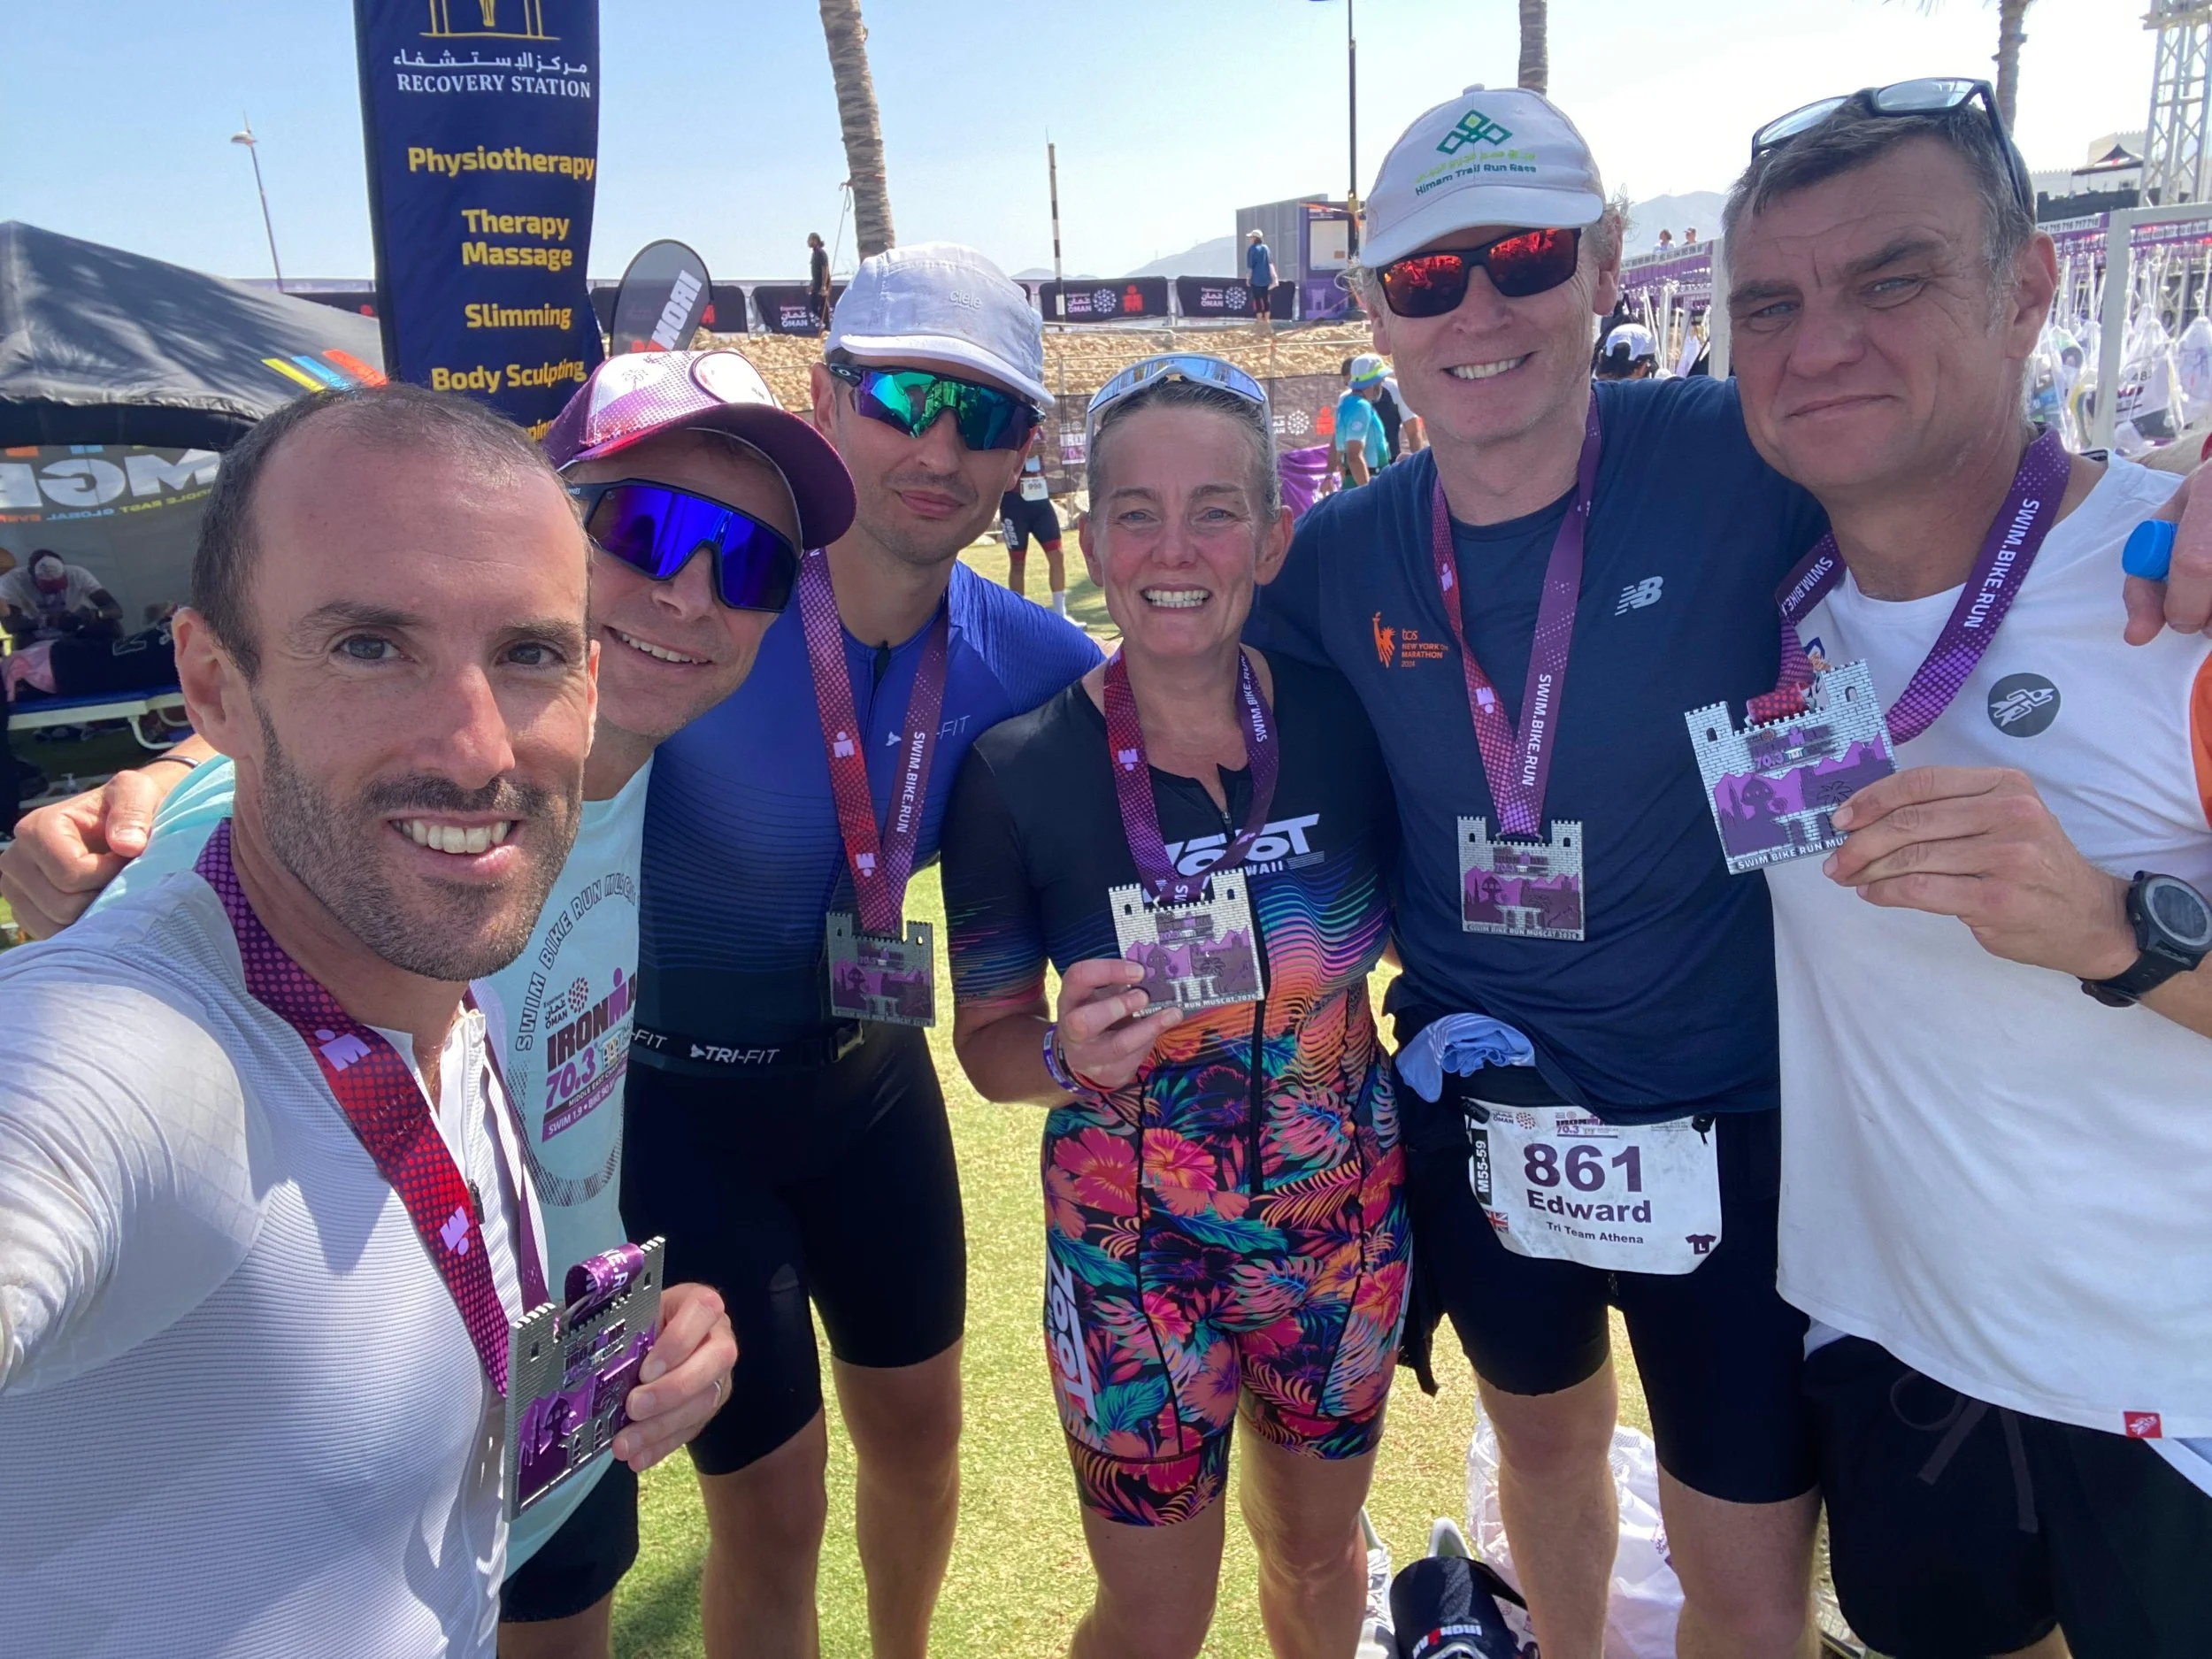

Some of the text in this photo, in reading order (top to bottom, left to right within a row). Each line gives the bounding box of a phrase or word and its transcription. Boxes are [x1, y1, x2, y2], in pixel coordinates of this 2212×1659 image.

[536, 56, 588, 73] مركز
[396, 73, 591, 98] RECOVERY STATION
[407, 145, 595, 181] Physiotherapy
[1416, 174, 1453, 196] Himam
[1455, 164, 1480, 177] Trail
[1509, 164, 1537, 173] Race
[461, 209, 571, 241] Therapy
[462, 241, 573, 272] Massage
[465, 303, 573, 331] Slimming
[781, 319, 809, 328] OMAN
[1068, 304, 1093, 313] OMAN
[431, 358, 588, 394] Body Sculpting
[1963, 498, 2040, 629] SWIM.BIKE.RUN
[1521, 674, 1552, 787] SWIM.BIKE.RUN
[896, 731, 926, 833] SWIM.BIKE.RUN
[1738, 855, 1769, 870] SWIM
[1772, 848, 1797, 862] BIKE
[1799, 841, 1823, 855] RUN
[1509, 927, 1525, 936] RUN
[1526, 929, 1556, 938] MUSCAT
[516, 972, 546, 1051] SWIM
[539, 910, 573, 970] BIKE
[571, 879, 603, 920] RUN
[1184, 1001, 1202, 1010] RUN
[1203, 996, 1236, 1006] MUSCAT
[546, 1009, 568, 1030] OMAN
[705, 1046, 780, 1064] TRI-FIT
[545, 1047, 595, 1110] 70.3
[569, 1087, 591, 1107] MIDDLE
[592, 1075, 605, 1090] EAST
[548, 1087, 610, 1135] SWIM 1.9 BIKE 90
[1493, 1116, 1514, 1125] OMAN
[1556, 1125, 1579, 1134] 70.3
[1476, 1140, 1490, 1194] M55-59
[1522, 1142, 1643, 1193] 861
[1525, 1188, 1653, 1224] Edward
[1546, 1220, 1645, 1244] Tri Team Athena
